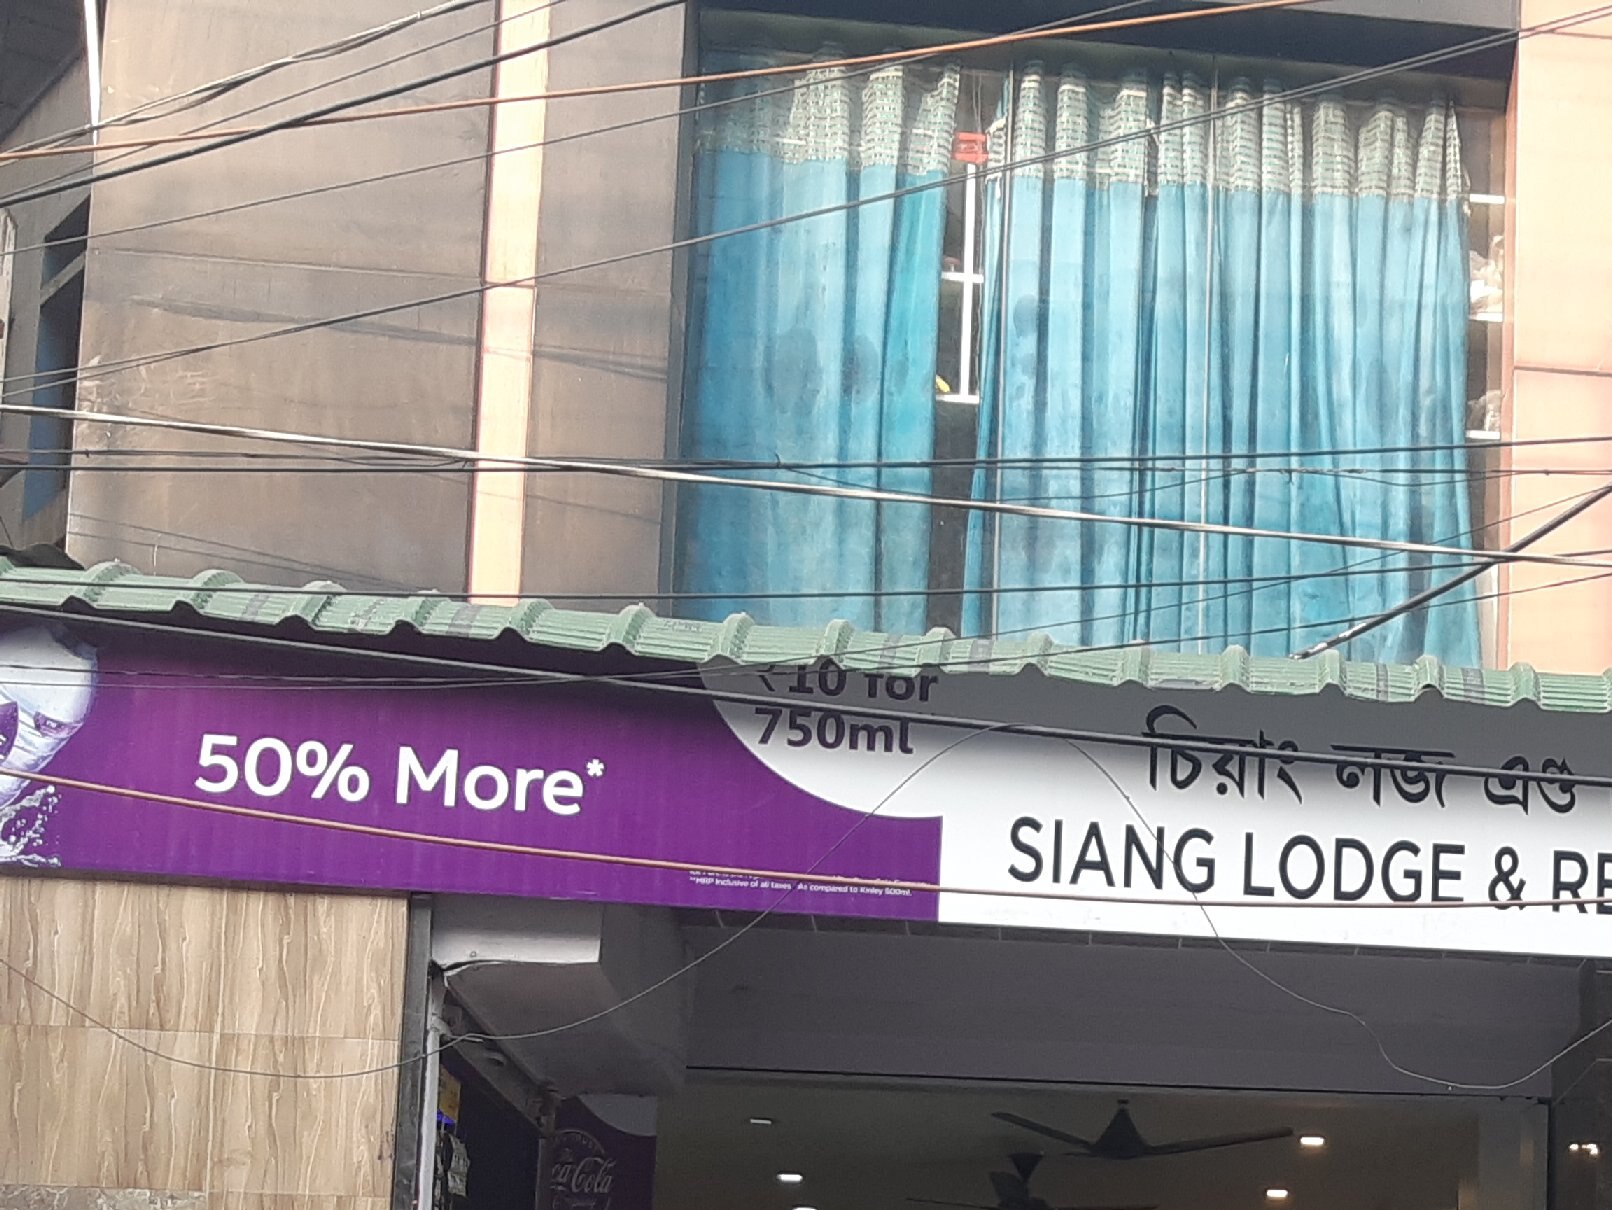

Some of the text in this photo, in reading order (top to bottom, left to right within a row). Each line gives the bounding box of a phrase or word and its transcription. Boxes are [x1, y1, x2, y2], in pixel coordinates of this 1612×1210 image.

[194, 733, 371, 803] 50%
[1008, 815, 1216, 893] SIANG
[1243, 831, 1465, 904] LODGE
[1488, 845, 1527, 910] &
